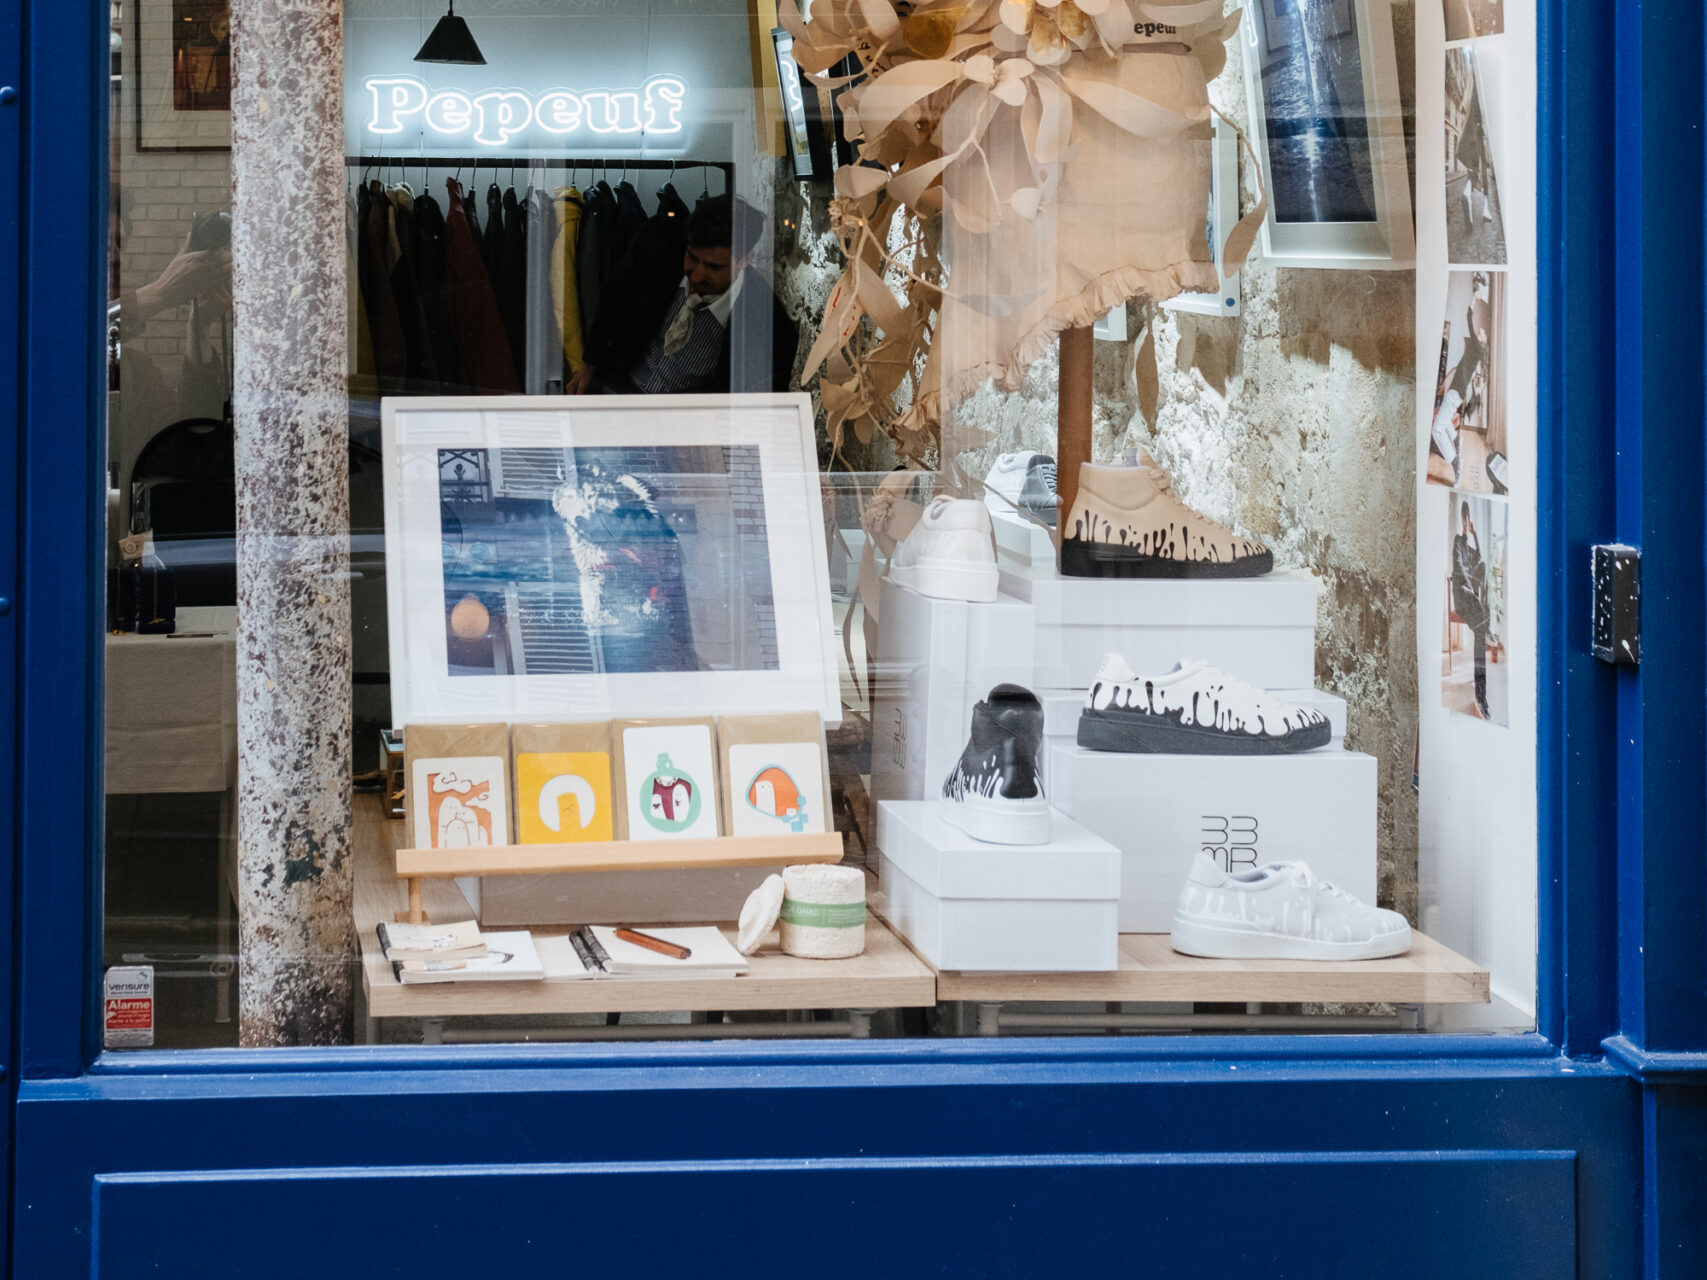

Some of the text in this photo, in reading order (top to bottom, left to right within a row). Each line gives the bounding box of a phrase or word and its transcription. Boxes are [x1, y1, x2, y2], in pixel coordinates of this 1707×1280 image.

[365, 77, 686, 146] Pepeuf
[108, 983, 151, 991] verisure
[108, 1000, 151, 1010] Alarme
